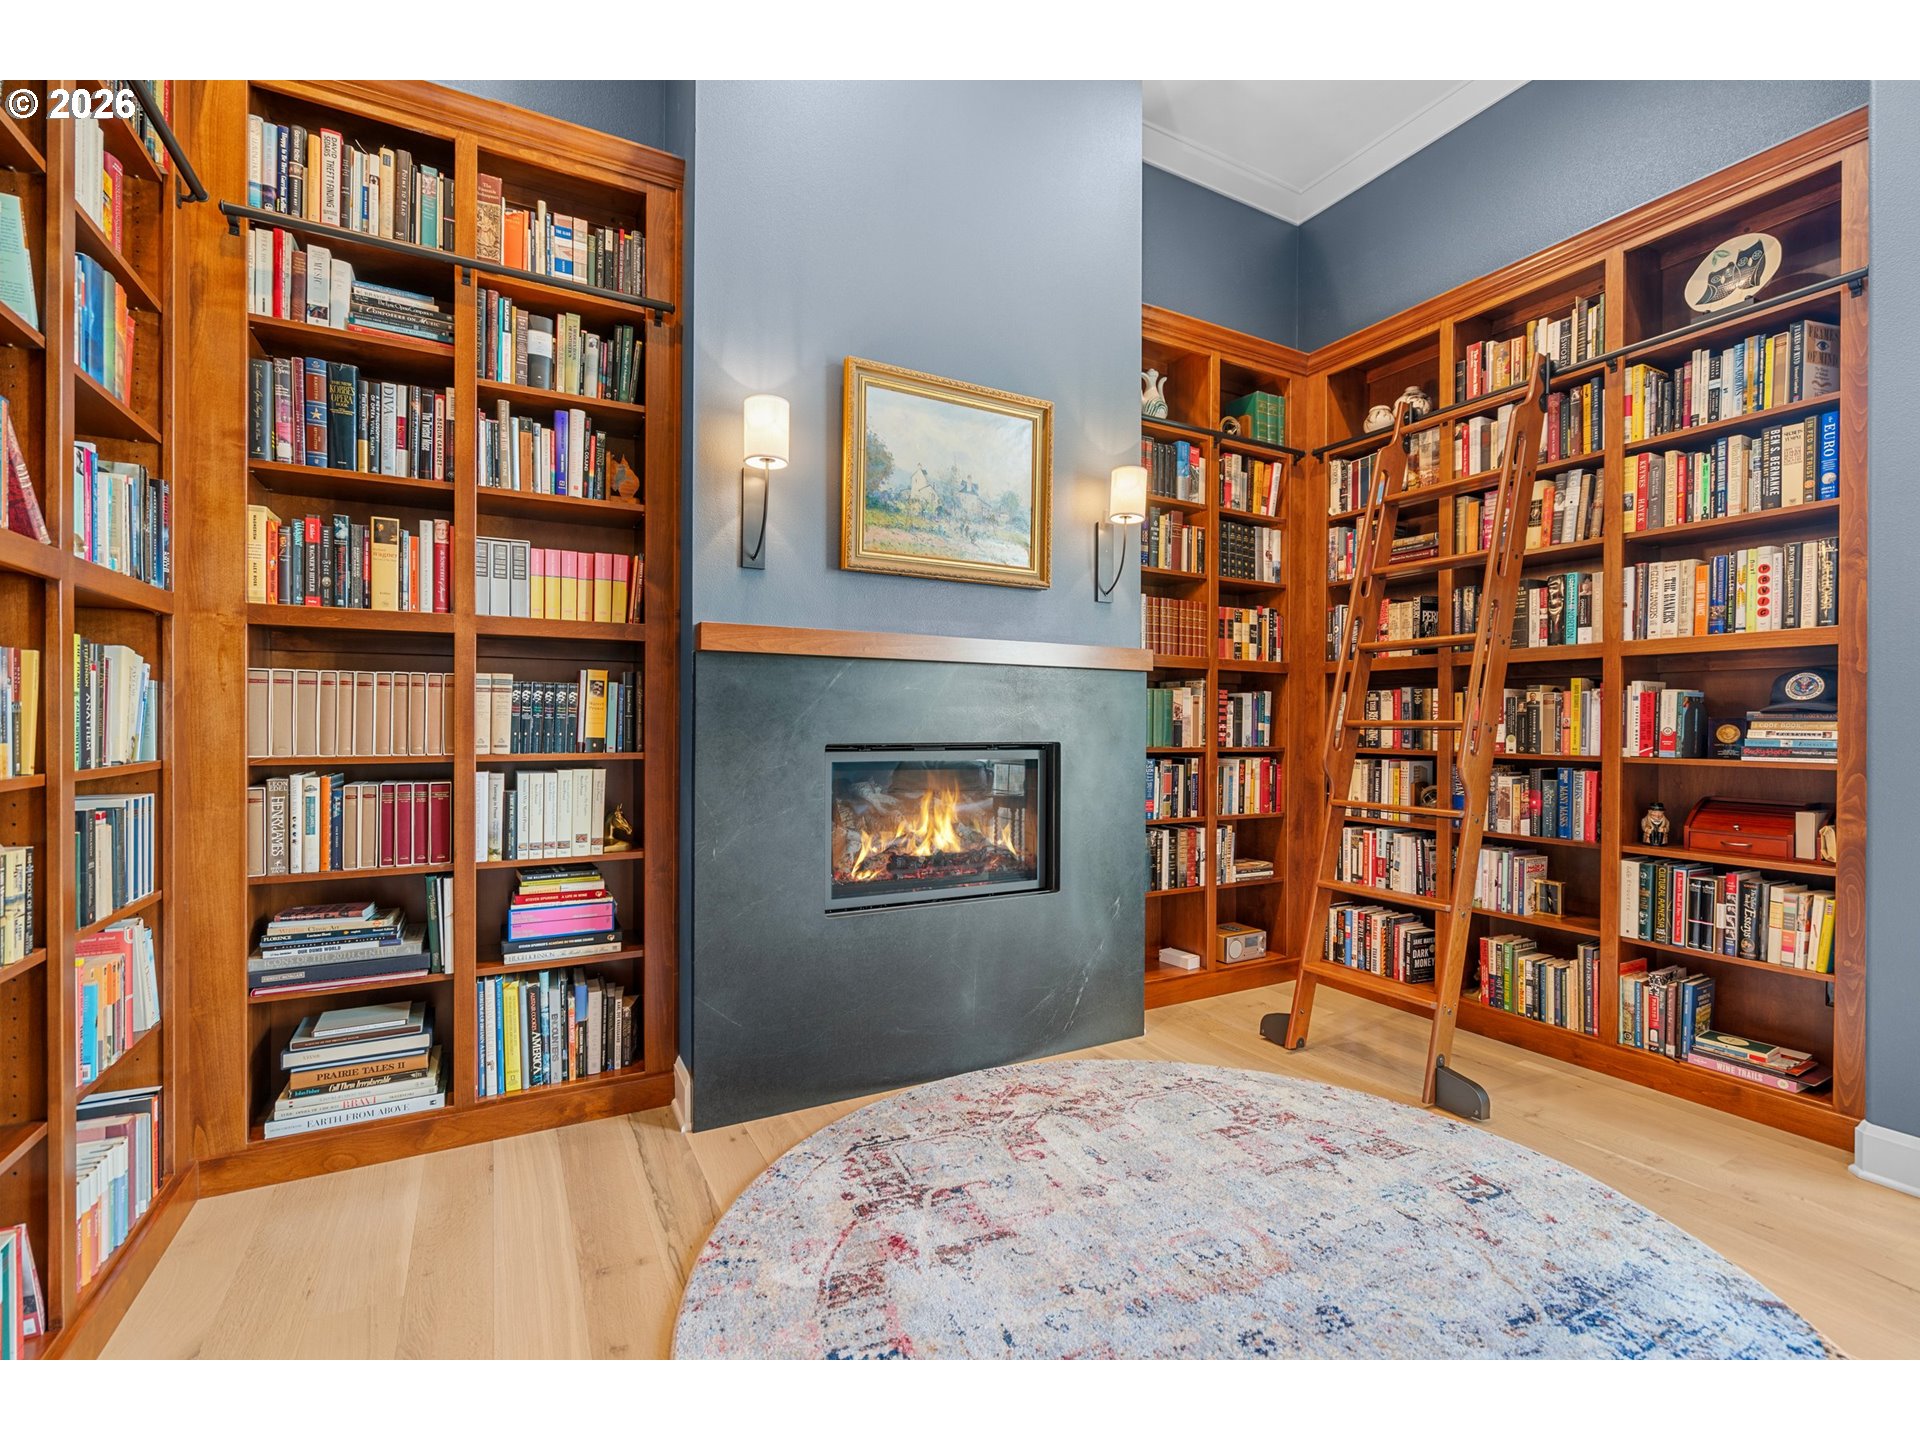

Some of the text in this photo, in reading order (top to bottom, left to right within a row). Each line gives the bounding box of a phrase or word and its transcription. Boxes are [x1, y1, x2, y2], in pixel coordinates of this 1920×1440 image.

[326, 160, 335, 208] THEFT FINDING
[314, 261, 322, 284] MUSIC
[366, 306, 406, 319] COMPOSERS
[330, 394, 354, 406] OPERA
[384, 385, 394, 415] DIVA
[422, 421, 432, 438] Twisted
[1770, 430, 1781, 444] BEN
[1823, 423, 1835, 456] EURO
[422, 438, 431, 451] Muse
[1731, 443, 1741, 464] Wealth
[1806, 445, 1813, 456] WE
[1730, 465, 1740, 478] and
[1770, 457, 1780, 496] BERNANKE
[337, 574, 345, 596] Wagner
[1663, 577, 1675, 623] THE BANKERS
[1804, 604, 1812, 619] BALL
[1567, 608, 1575, 639] NORTON
[1218, 689, 1228, 742] HITLER
[1575, 774, 1583, 799] LEADERS
[271, 796, 284, 856] HENRY JAMES
[1657, 898, 1665, 928] AMNESIA
[1742, 908, 1756, 938] Essays
[264, 958, 290, 967] ICONS
[330, 952, 354, 960] 20TH
[357, 946, 398, 958] CENTURY
[1413, 949, 1429, 959] DARK
[1414, 958, 1435, 968] MONEY
[531, 1031, 542, 1075] AMERICA
[316, 1062, 405, 1081] PRAIRIE TALES II
[1716, 1062, 1763, 1082] WINE TRAILS
[329, 1084, 339, 1092] Call
[357, 1076, 392, 1087] Irreplaceable
[307, 1104, 410, 1128] EARTH FROM ABOVE
